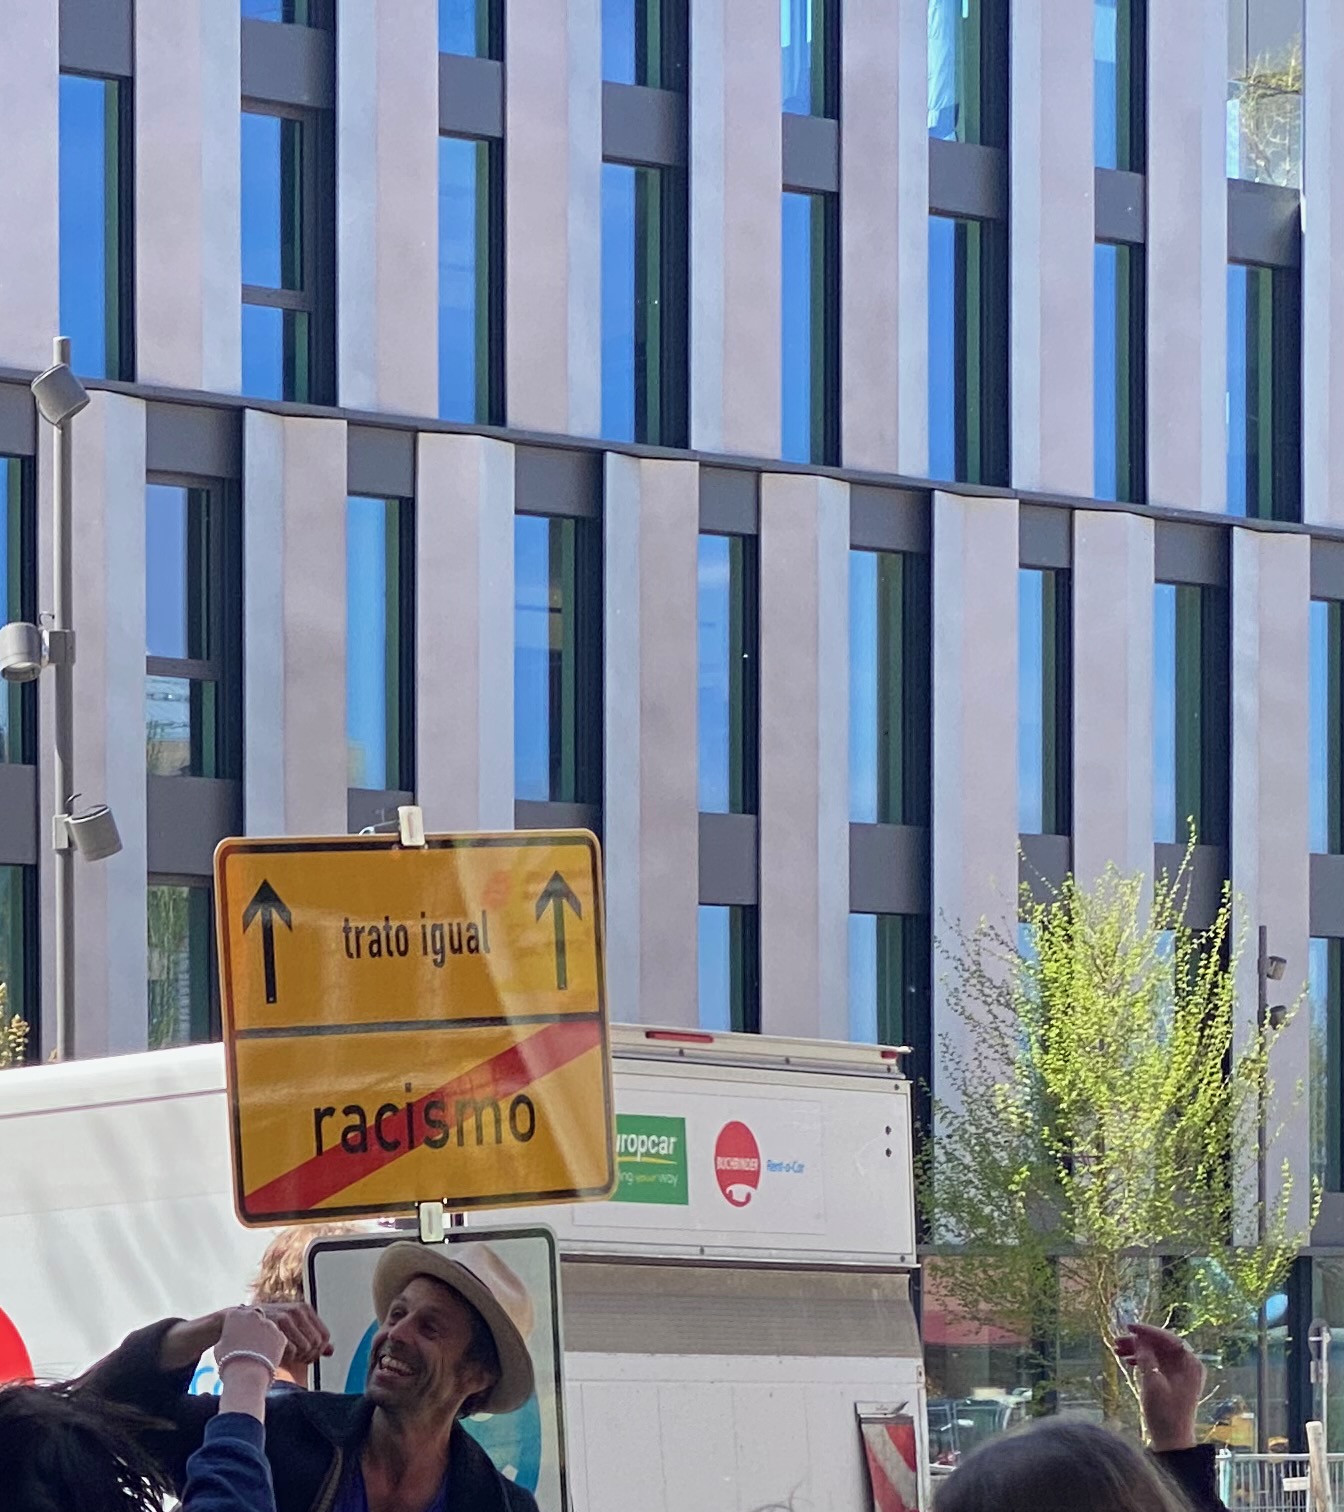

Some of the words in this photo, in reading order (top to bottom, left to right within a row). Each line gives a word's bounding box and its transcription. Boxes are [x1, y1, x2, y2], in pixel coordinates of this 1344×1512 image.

[342, 915, 409, 959] trato
[421, 910, 491, 968] igual
[313, 1082, 536, 1157] racismo
